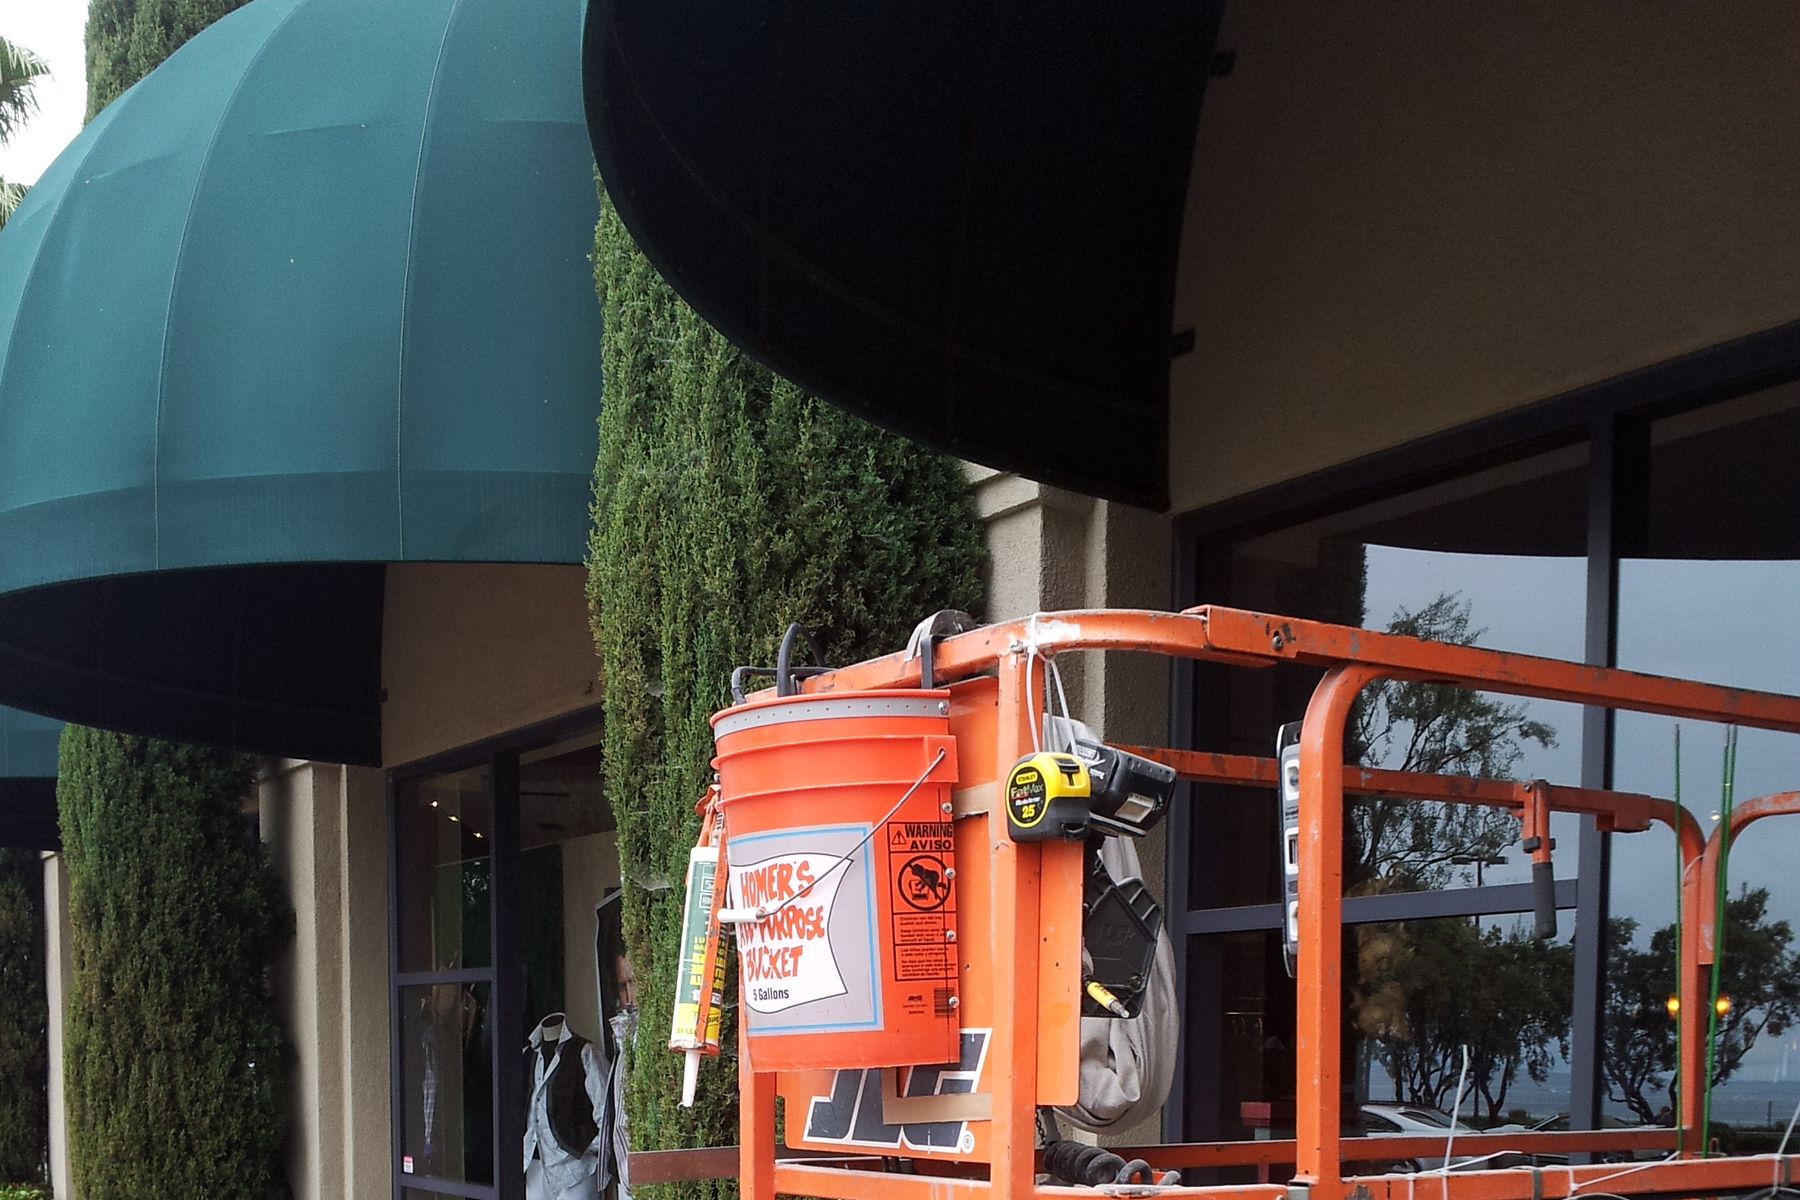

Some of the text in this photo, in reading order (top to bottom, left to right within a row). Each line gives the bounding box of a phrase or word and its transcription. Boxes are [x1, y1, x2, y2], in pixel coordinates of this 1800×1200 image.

[905, 824, 953, 838] WARNING
[910, 839, 952, 850] AVISO
[740, 860, 815, 909] HOMER'S
[746, 945, 804, 983] BUCKET
[753, 987, 790, 1001] 5 Gallons
